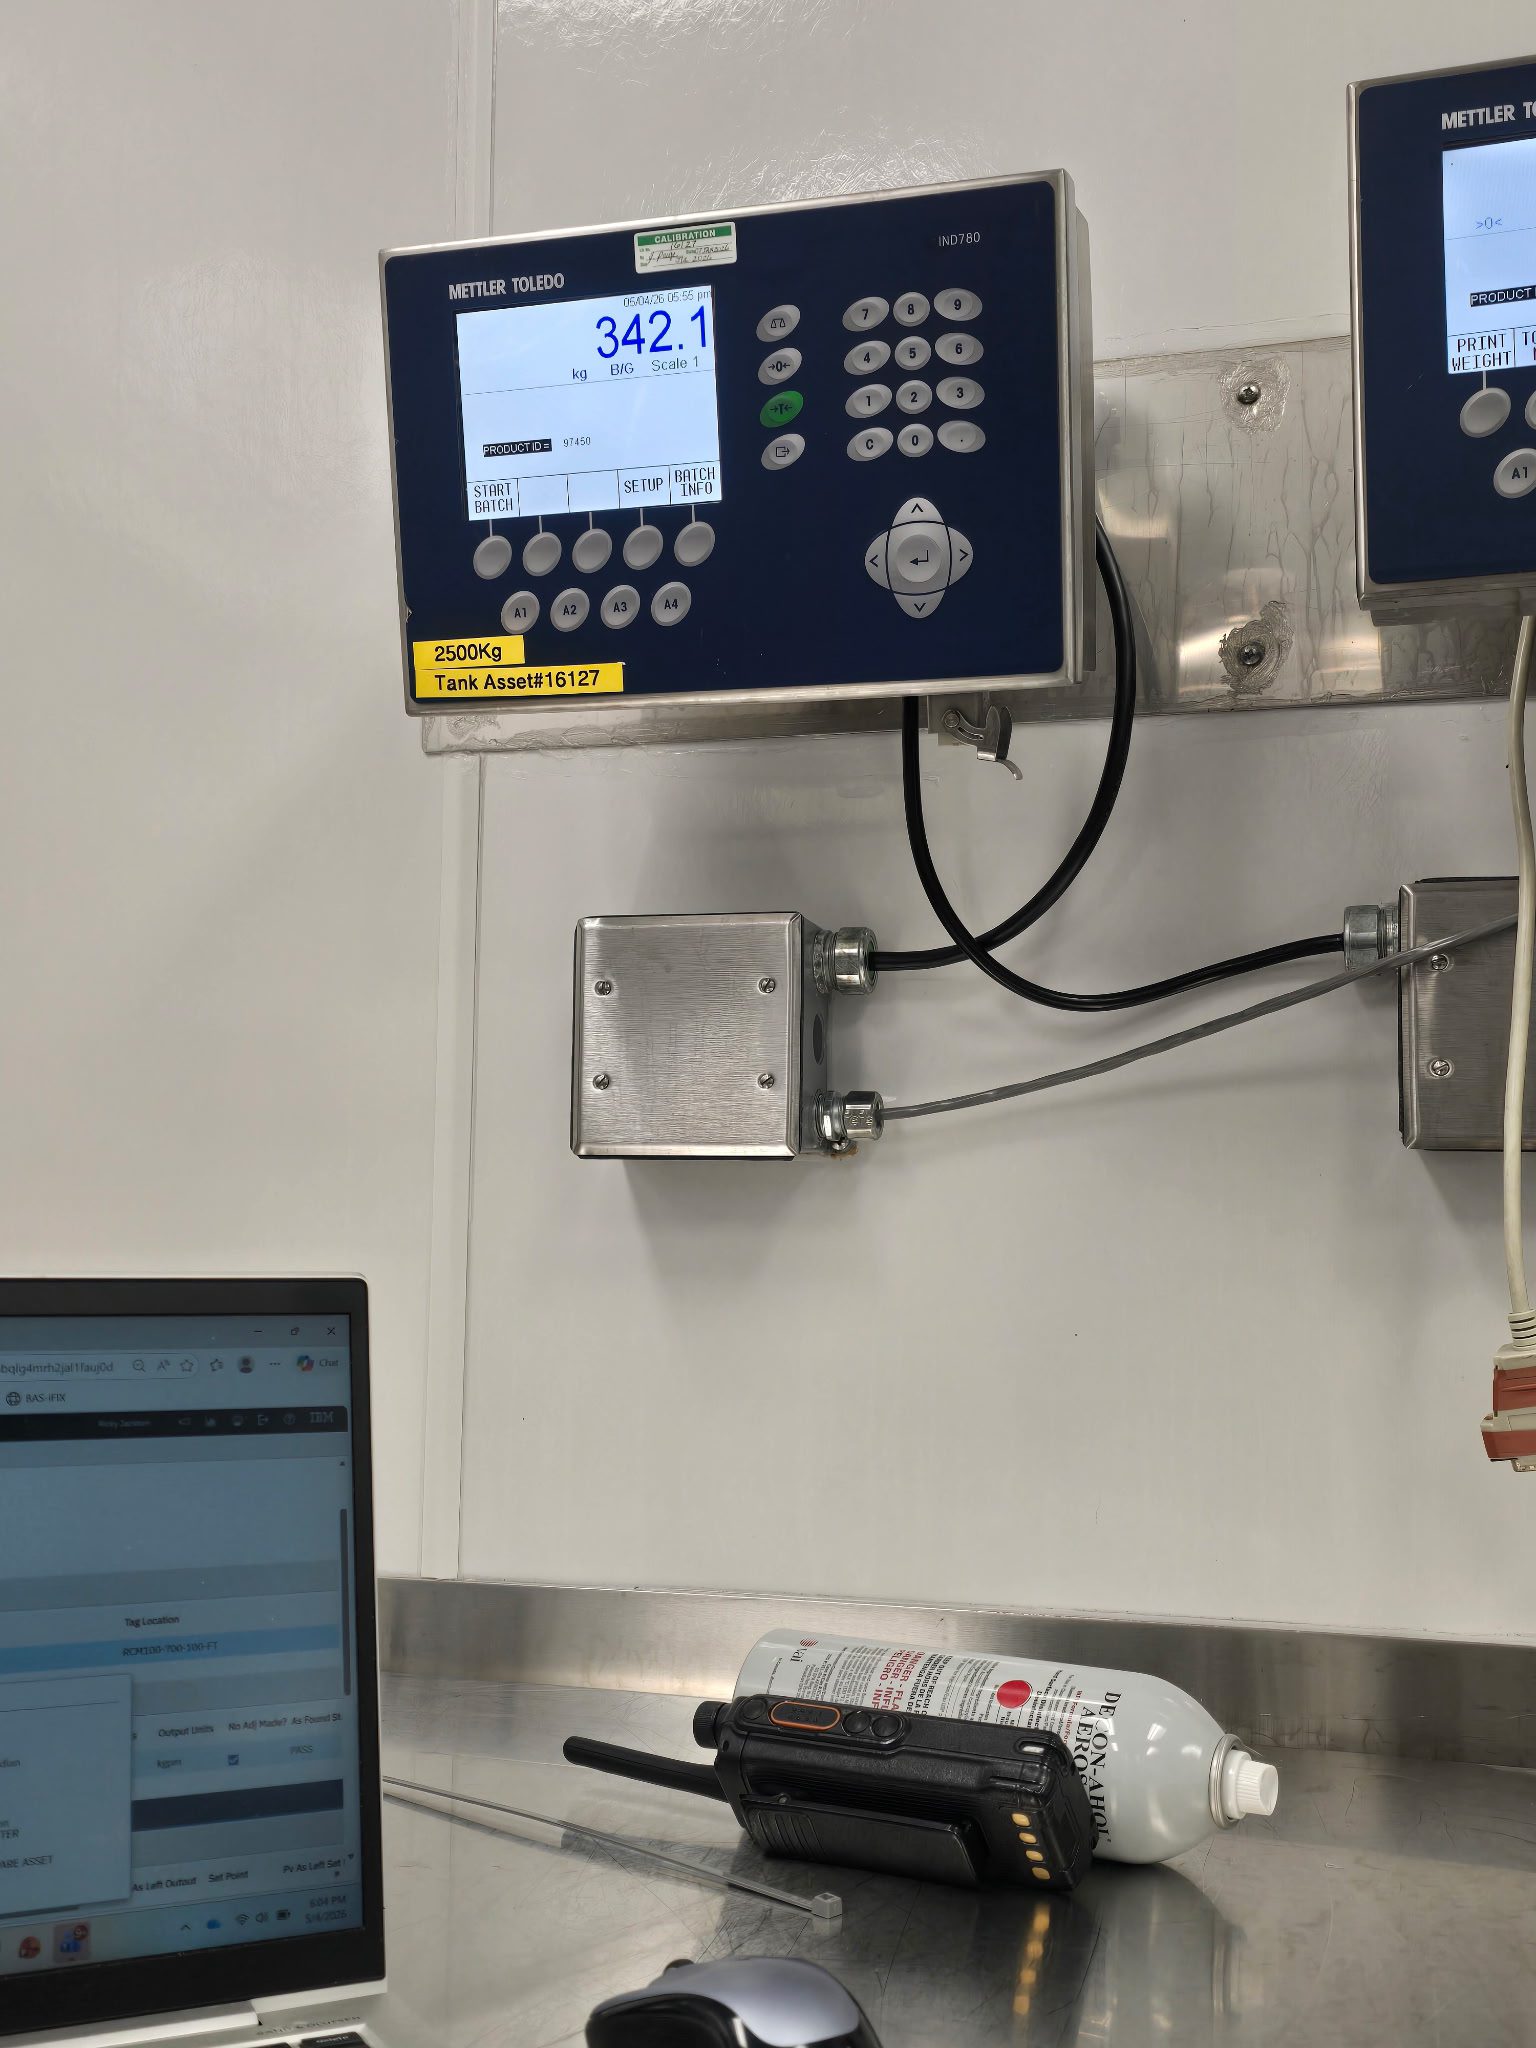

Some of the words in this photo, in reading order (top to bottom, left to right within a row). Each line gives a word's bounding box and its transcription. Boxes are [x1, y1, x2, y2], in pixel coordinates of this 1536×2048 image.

[1441, 104, 1516, 130] METTLER
[654, 229, 716, 243] CALIBRATION
[938, 231, 981, 247] IND780
[449, 279, 506, 300] METTLER
[511, 272, 565, 293] TOLEDO
[623, 294, 665, 308] 05/04/26
[667, 290, 694, 303] 05:55
[1470, 287, 1532, 307] PRODUCT
[907, 304, 915, 315] 8
[953, 299, 962, 311] 9
[861, 309, 869, 320] 7
[595, 305, 707, 359] 342.1
[955, 342, 963, 354] 6
[1457, 333, 1507, 353] PRINT
[863, 352, 871, 364] 4
[909, 347, 916, 359] 5
[1452, 350, 1512, 371] WEIGHT
[572, 368, 588, 381] kg
[610, 362, 635, 376] B/G
[651, 357, 688, 372] Scale
[692, 356, 699, 368] 1
[910, 392, 918, 403] 2
[956, 387, 964, 399] 3
[865, 395, 871, 407] 1
[563, 436, 592, 447] 97450
[865, 439, 874, 450] C
[911, 434, 919, 446] 0
[483, 442, 530, 456] PRODUCT
[532, 441, 542, 452] ID
[674, 467, 716, 483] BATCH
[1511, 466, 1529, 480] A1
[473, 483, 512, 498] START
[624, 478, 664, 494] SETUP
[680, 481, 713, 497] INFO
[475, 498, 513, 514] BATCH
[562, 604, 577, 616] A2
[613, 602, 628, 613] A3
[664, 598, 679, 610] A4
[514, 607, 528, 619] A1
[434, 642, 502, 662] 2500Kg
[434, 673, 479, 691] Tank
[483, 669, 600, 690] Asset#16127
[319, 1359, 339, 1368] Chat
[309, 1411, 334, 1424] IBM
[125, 1617, 140, 1628] Tag
[142, 1615, 180, 1627] Location
[158, 1727, 189, 1739] Output
[228, 1723, 241, 1731] No
[243, 1721, 257, 1731] Adj
[259, 1718, 287, 1728] Made?
[291, 1716, 301, 1725] As
[304, 1714, 330, 1724] Found
[290, 1745, 313, 1754] PASS
[22, 1855, 54, 1866] ASSET
[297, 1863, 307, 1872] As
[309, 1861, 325, 1871] Left
[327, 1859, 341, 1869] Set
[331, 1896, 347, 1905] PM
